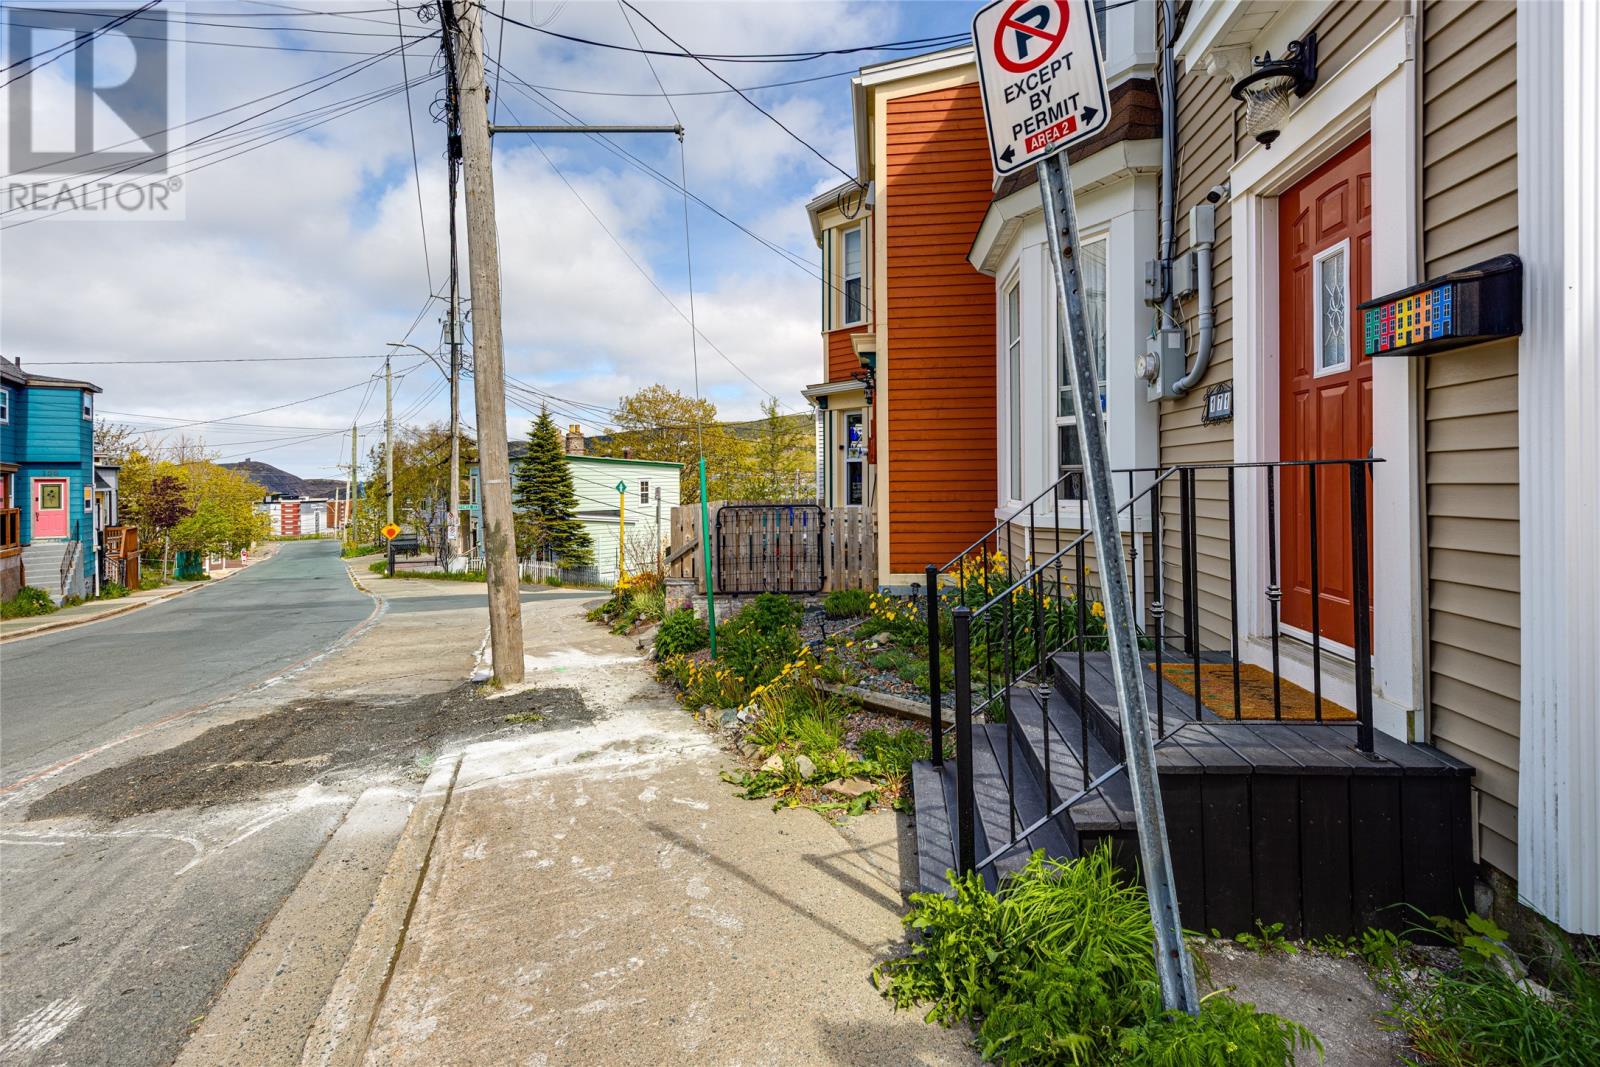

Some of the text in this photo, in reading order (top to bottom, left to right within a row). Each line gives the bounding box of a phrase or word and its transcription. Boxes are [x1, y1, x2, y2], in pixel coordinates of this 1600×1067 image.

[1004, 52, 1073, 104] EXCEPT
[1012, 92, 1080, 141] PERMIT
[1029, 85, 1052, 111] BY
[1031, 121, 1070, 150] AREA 2
